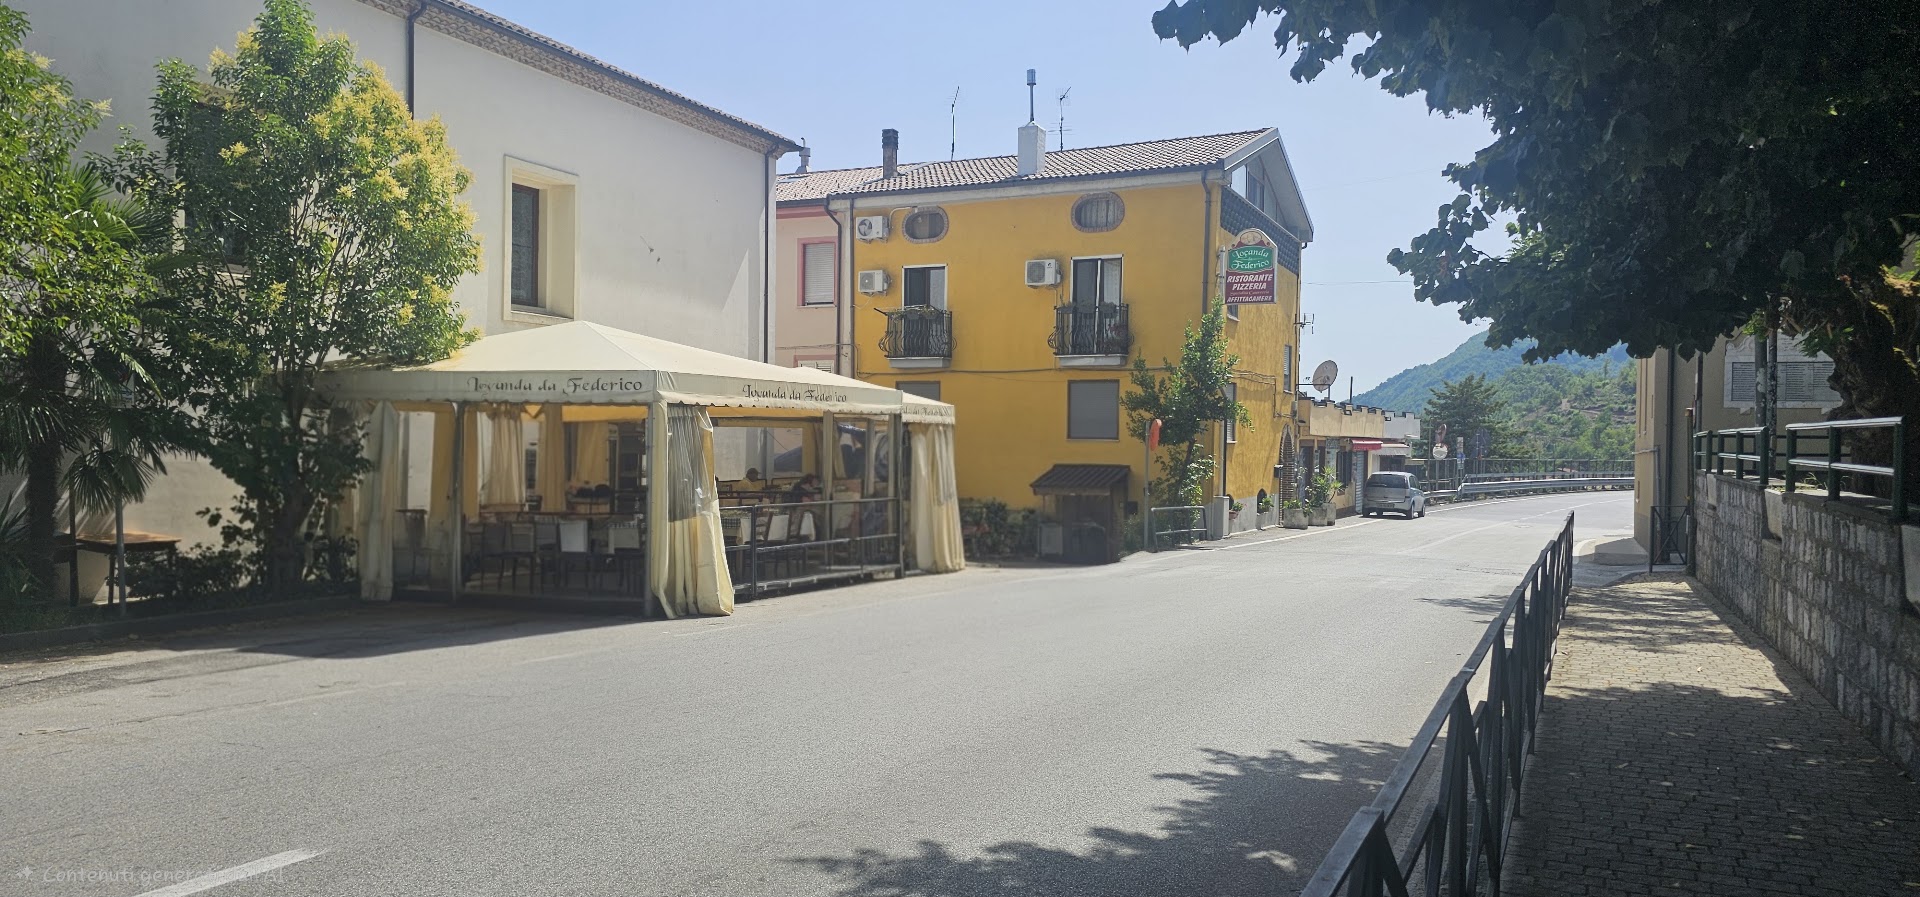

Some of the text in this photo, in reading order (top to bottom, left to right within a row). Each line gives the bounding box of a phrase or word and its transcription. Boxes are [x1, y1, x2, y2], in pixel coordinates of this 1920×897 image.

[1231, 260, 1270, 269] Federico
[1227, 274, 1273, 283] RISTORANTE
[1232, 282, 1267, 290] PIZZERIA
[538, 379, 556, 391] da
[563, 377, 643, 396] Federico
[790, 388, 800, 400] da
